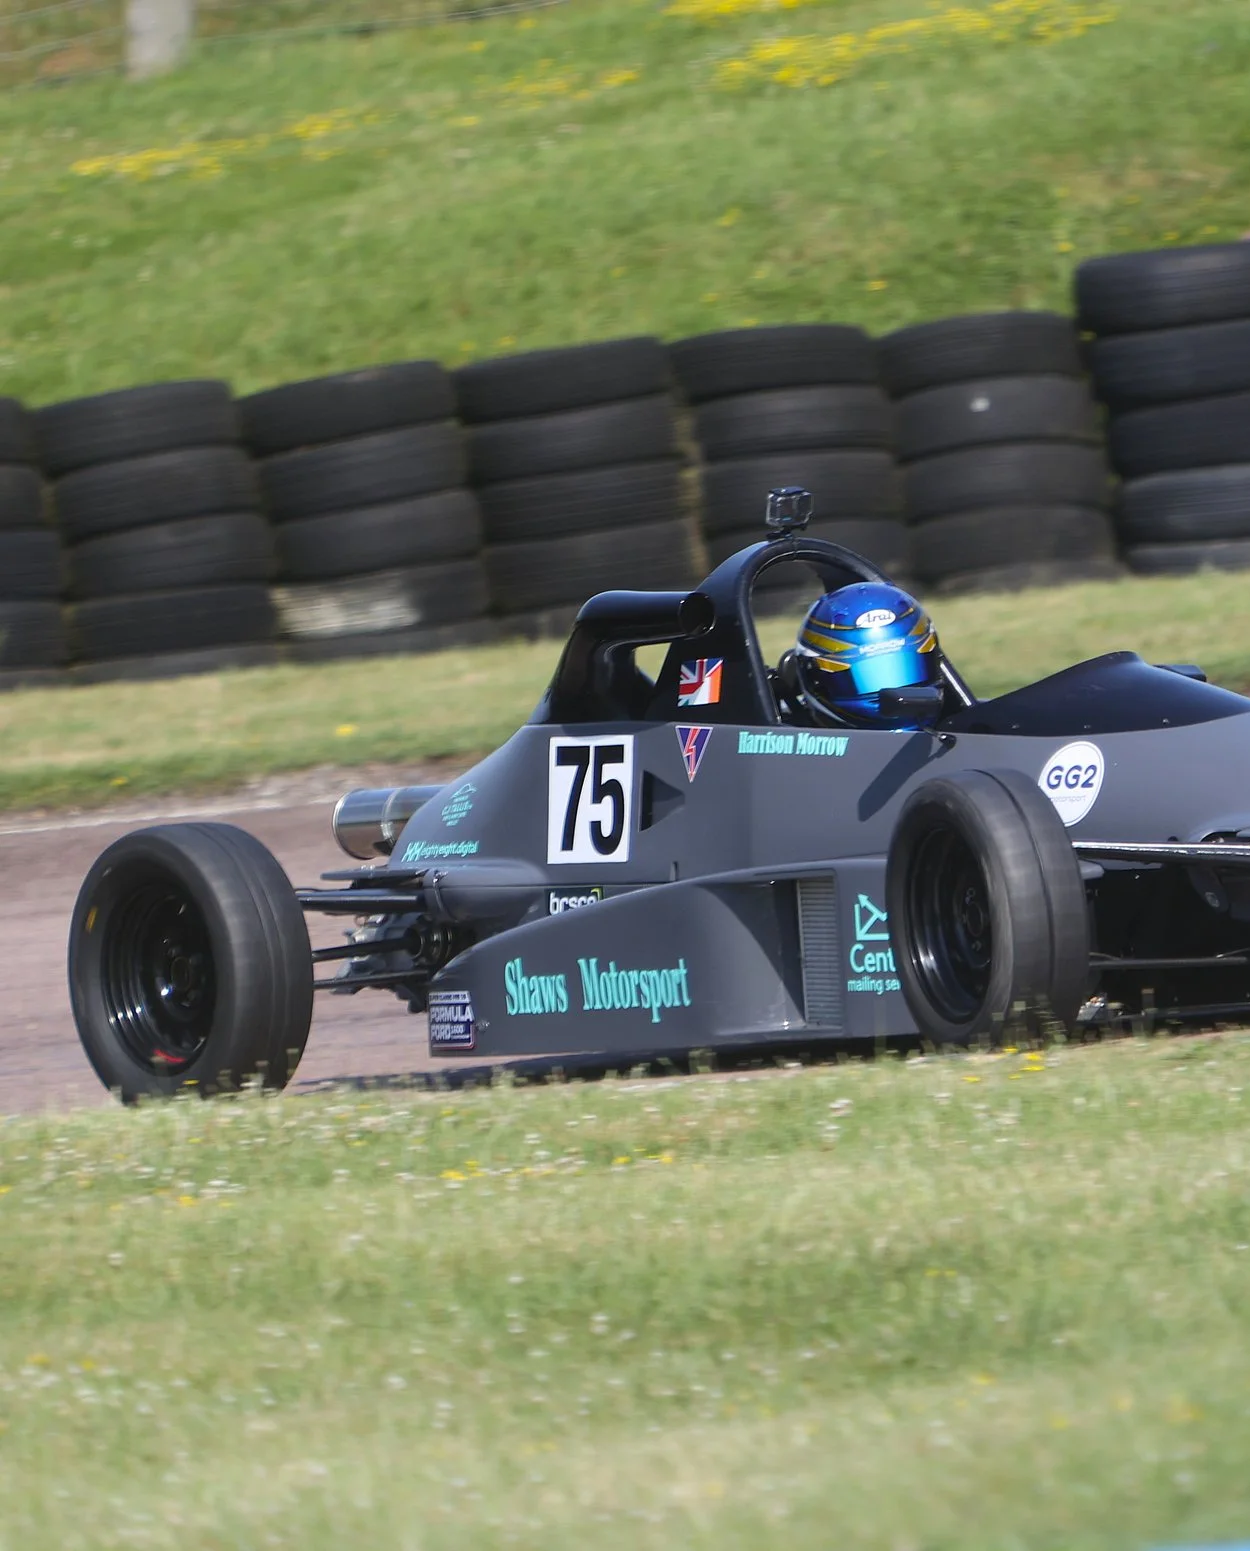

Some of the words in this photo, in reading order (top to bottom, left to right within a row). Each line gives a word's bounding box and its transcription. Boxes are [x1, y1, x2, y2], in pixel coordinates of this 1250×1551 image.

[738, 731, 794, 754] Harrison
[796, 732, 849, 757] Morrow
[1046, 764, 1097, 790] GG2
[556, 744, 624, 855] 75
[505, 957, 568, 1015] Shaws
[577, 958, 692, 1023] Motorsport
[847, 976, 884, 995] mailing
[430, 1005, 474, 1022] FORMULA
[430, 1024, 451, 1041] FORD
